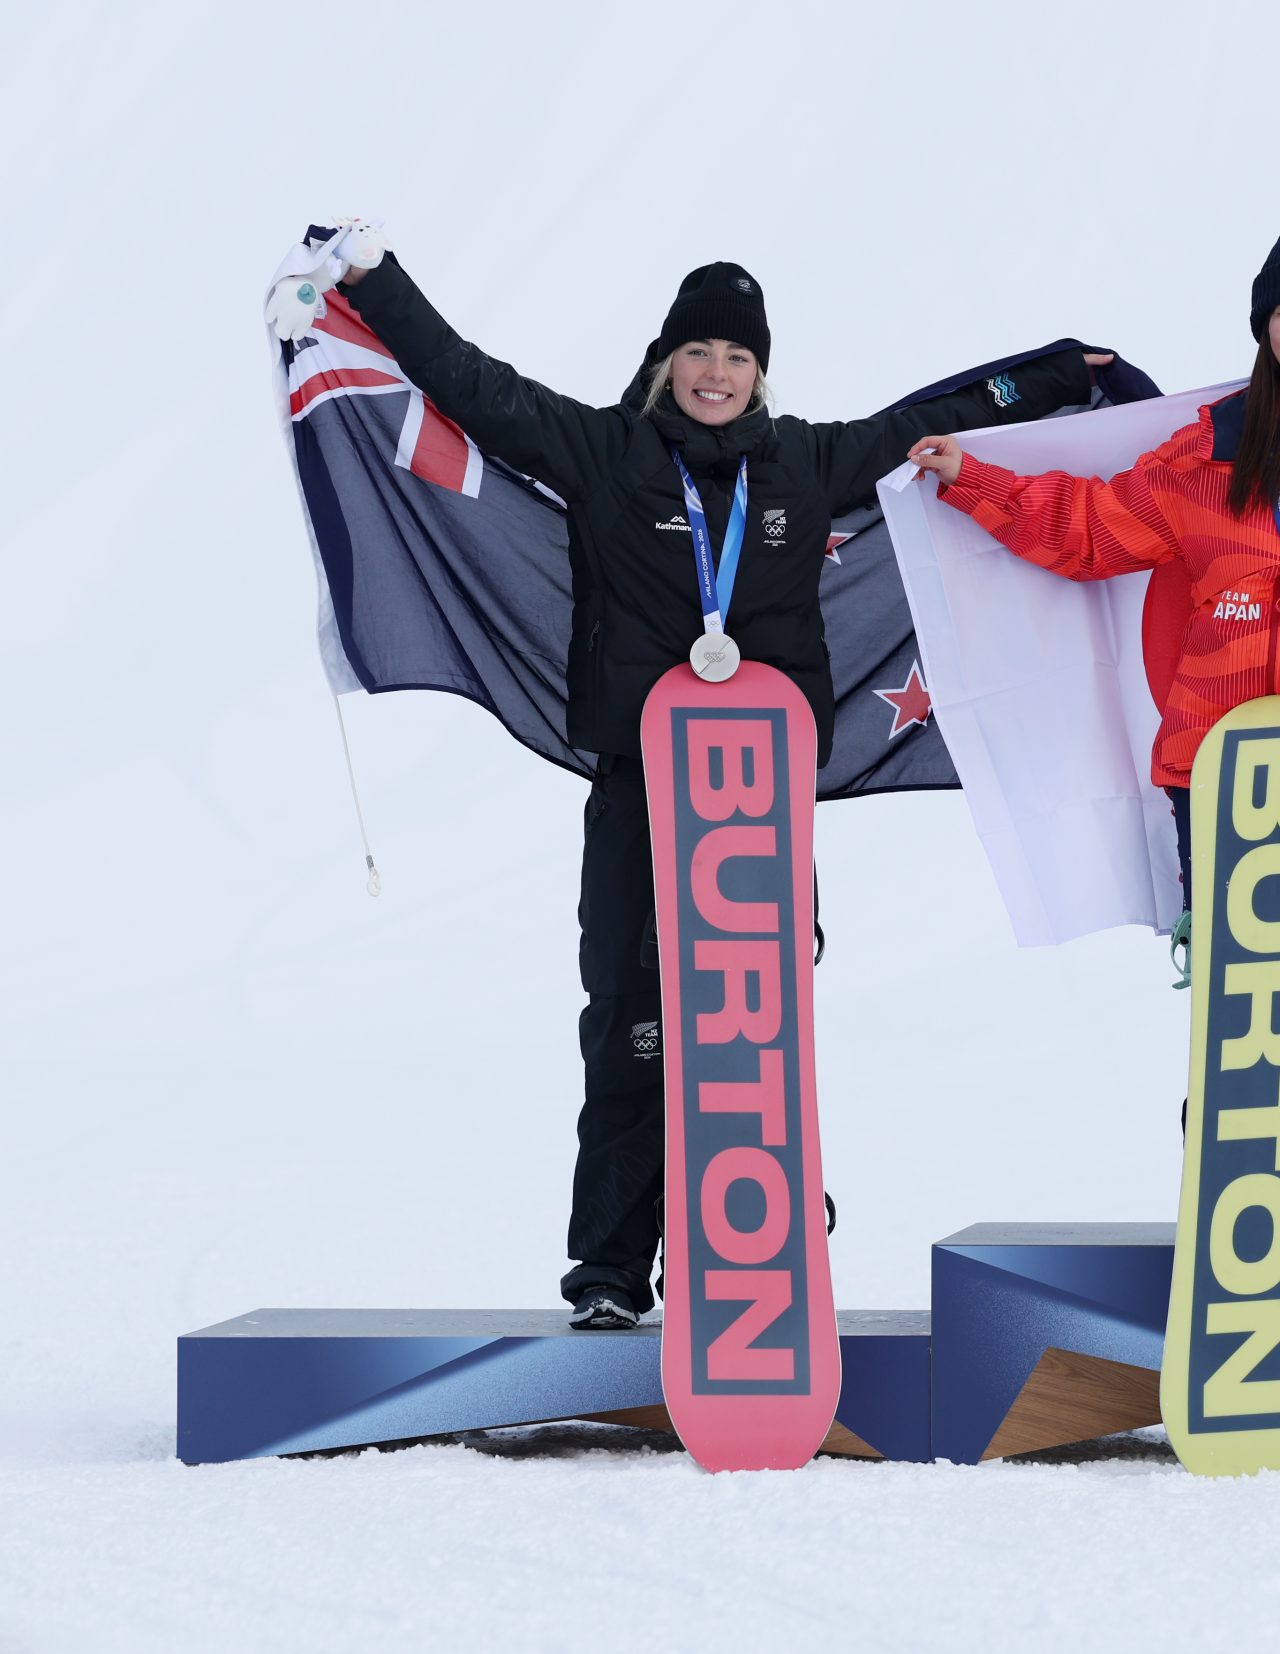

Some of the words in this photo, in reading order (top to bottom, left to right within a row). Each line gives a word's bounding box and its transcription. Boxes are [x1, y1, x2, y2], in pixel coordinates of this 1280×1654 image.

[655, 522, 692, 532] Kathman
[697, 528, 705, 542] 2026
[700, 543, 709, 571] CORTINA
[703, 571, 712, 599] MILANO
[1221, 590, 1250, 603] TEAM
[1213, 601, 1261, 621] APAN
[686, 719, 795, 1381] BURTON
